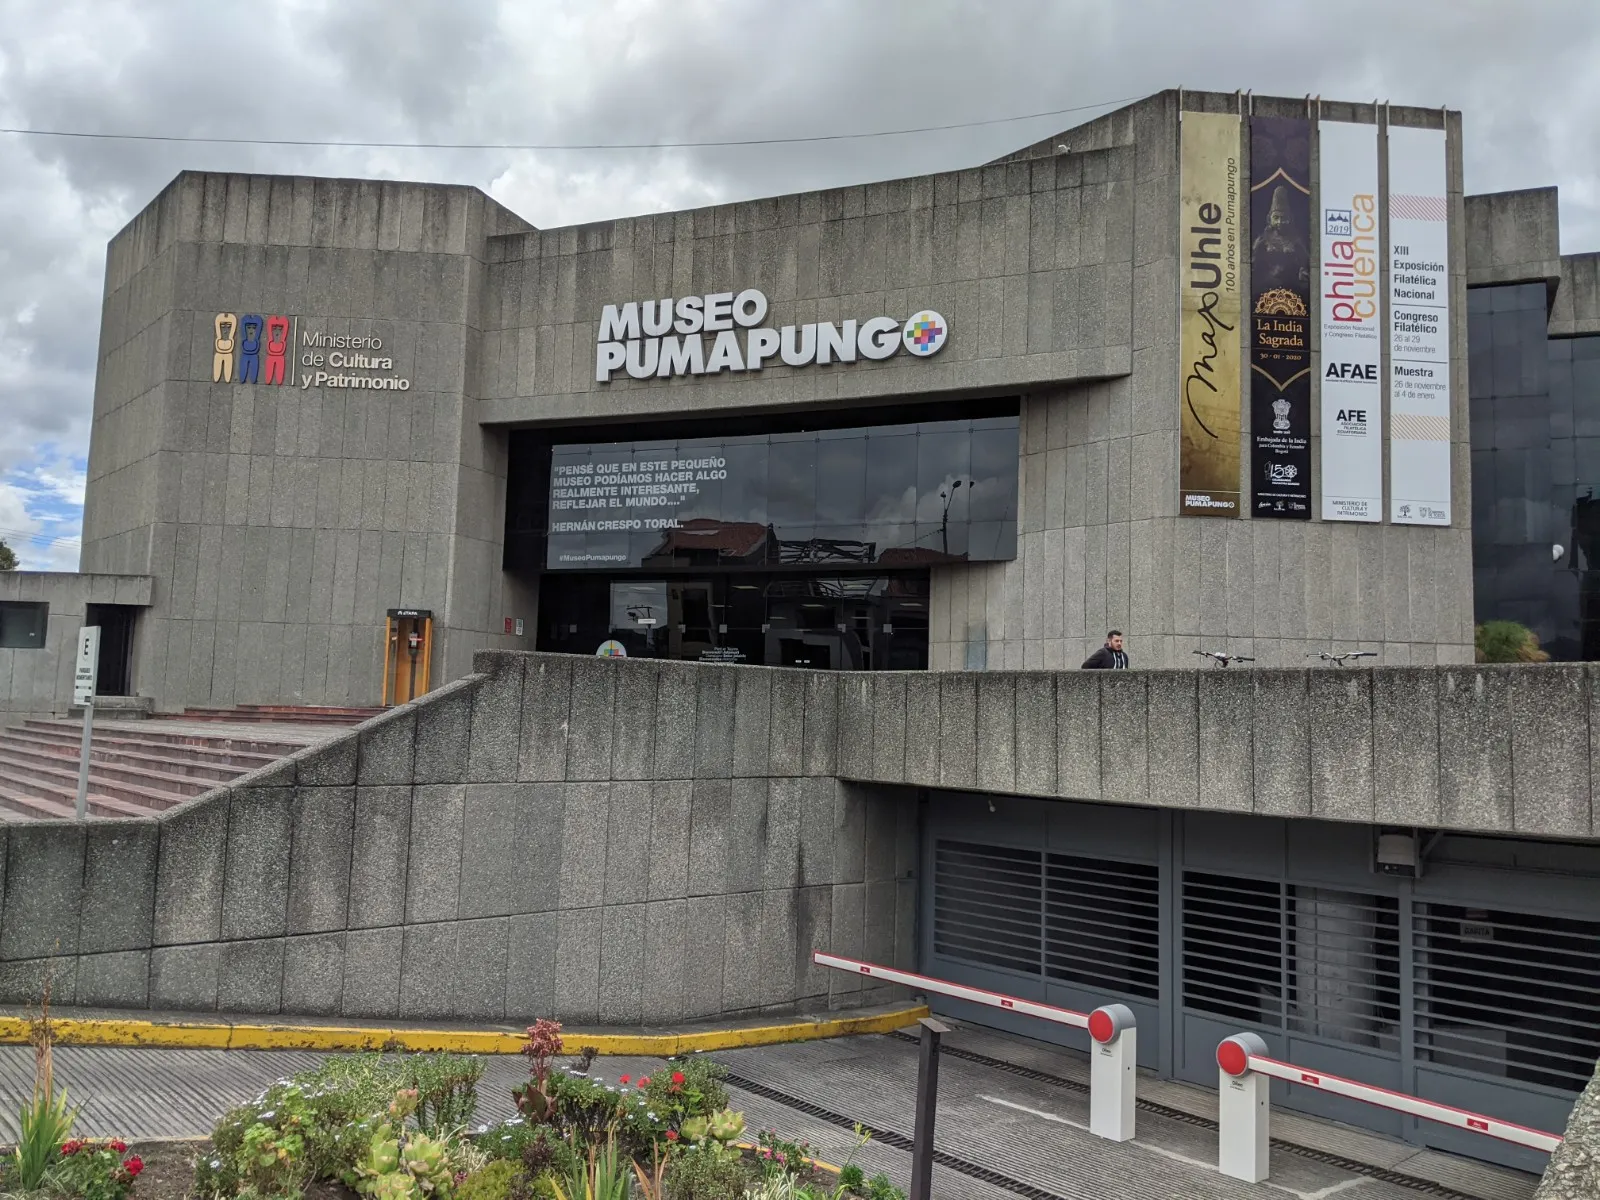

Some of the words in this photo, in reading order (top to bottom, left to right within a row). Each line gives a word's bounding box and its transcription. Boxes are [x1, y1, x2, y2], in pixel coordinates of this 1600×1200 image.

[1225, 157, 1238, 225] Pumapungo
[1228, 227, 1236, 243] en
[1328, 224, 1349, 233] 2019
[1190, 202, 1222, 289] Uhle
[1393, 245, 1409, 256] XIII
[1226, 243, 1236, 270] años
[1352, 194, 1376, 319] cuenca
[1393, 259, 1444, 272] Exposición
[1226, 271, 1236, 293] 100
[1324, 241, 1362, 322] phila
[1393, 273, 1436, 286] Filatélica
[1394, 287, 1435, 300] Nacional
[598, 289, 768, 342] MUSEO
[1394, 310, 1439, 323] Congreso
[1257, 319, 1271, 331] La
[1274, 320, 1303, 333] India
[1324, 323, 1352, 331] Exposición
[1394, 321, 1437, 334] Filatélico
[302, 331, 382, 350] Ministerio
[1258, 333, 1304, 348] Sagrada
[1328, 331, 1354, 339] Congreso
[1404, 334, 1411, 343] al
[1411, 335, 1421, 343] 29
[1394, 344, 1403, 352] de
[1403, 344, 1436, 354] noviembre
[301, 351, 324, 367] de
[328, 352, 393, 370] Cultura
[1325, 362, 1378, 380] AFAE
[1394, 366, 1434, 378] Muestra
[301, 373, 311, 390] y
[315, 371, 410, 391] Patrimonio
[1394, 380, 1404, 388] 26
[1404, 380, 1413, 389] de
[1413, 381, 1447, 391] noviembre
[1394, 389, 1401, 398] al
[1401, 390, 1406, 398] 4
[1407, 390, 1416, 399] de
[1416, 391, 1436, 400] enero
[1336, 409, 1367, 422] AFE
[554, 462, 594, 476] "PENSÉ
[596, 463, 619, 475] QUE
[622, 462, 637, 473] EN
[639, 460, 668, 472] ESTE
[671, 456, 726, 470] PEQUEÑO
[553, 476, 592, 487] MUSEO
[594, 472, 653, 486] PODÍAMOS
[655, 471, 693, 483] HACER
[695, 469, 727, 481] ALGO
[552, 486, 618, 499] REALMENTE
[620, 483, 700, 496] INTERESANTE,
[552, 498, 607, 510] REFLEJAR
[609, 498, 623, 508] EL
[1185, 494, 1211, 502] MUSEO
[552, 519, 596, 532] HERNÁN
[597, 519, 641, 531] CRESPO
[644, 518, 684, 529] TORAL.
[559, 554, 627, 562] #MuseoPumapungo
